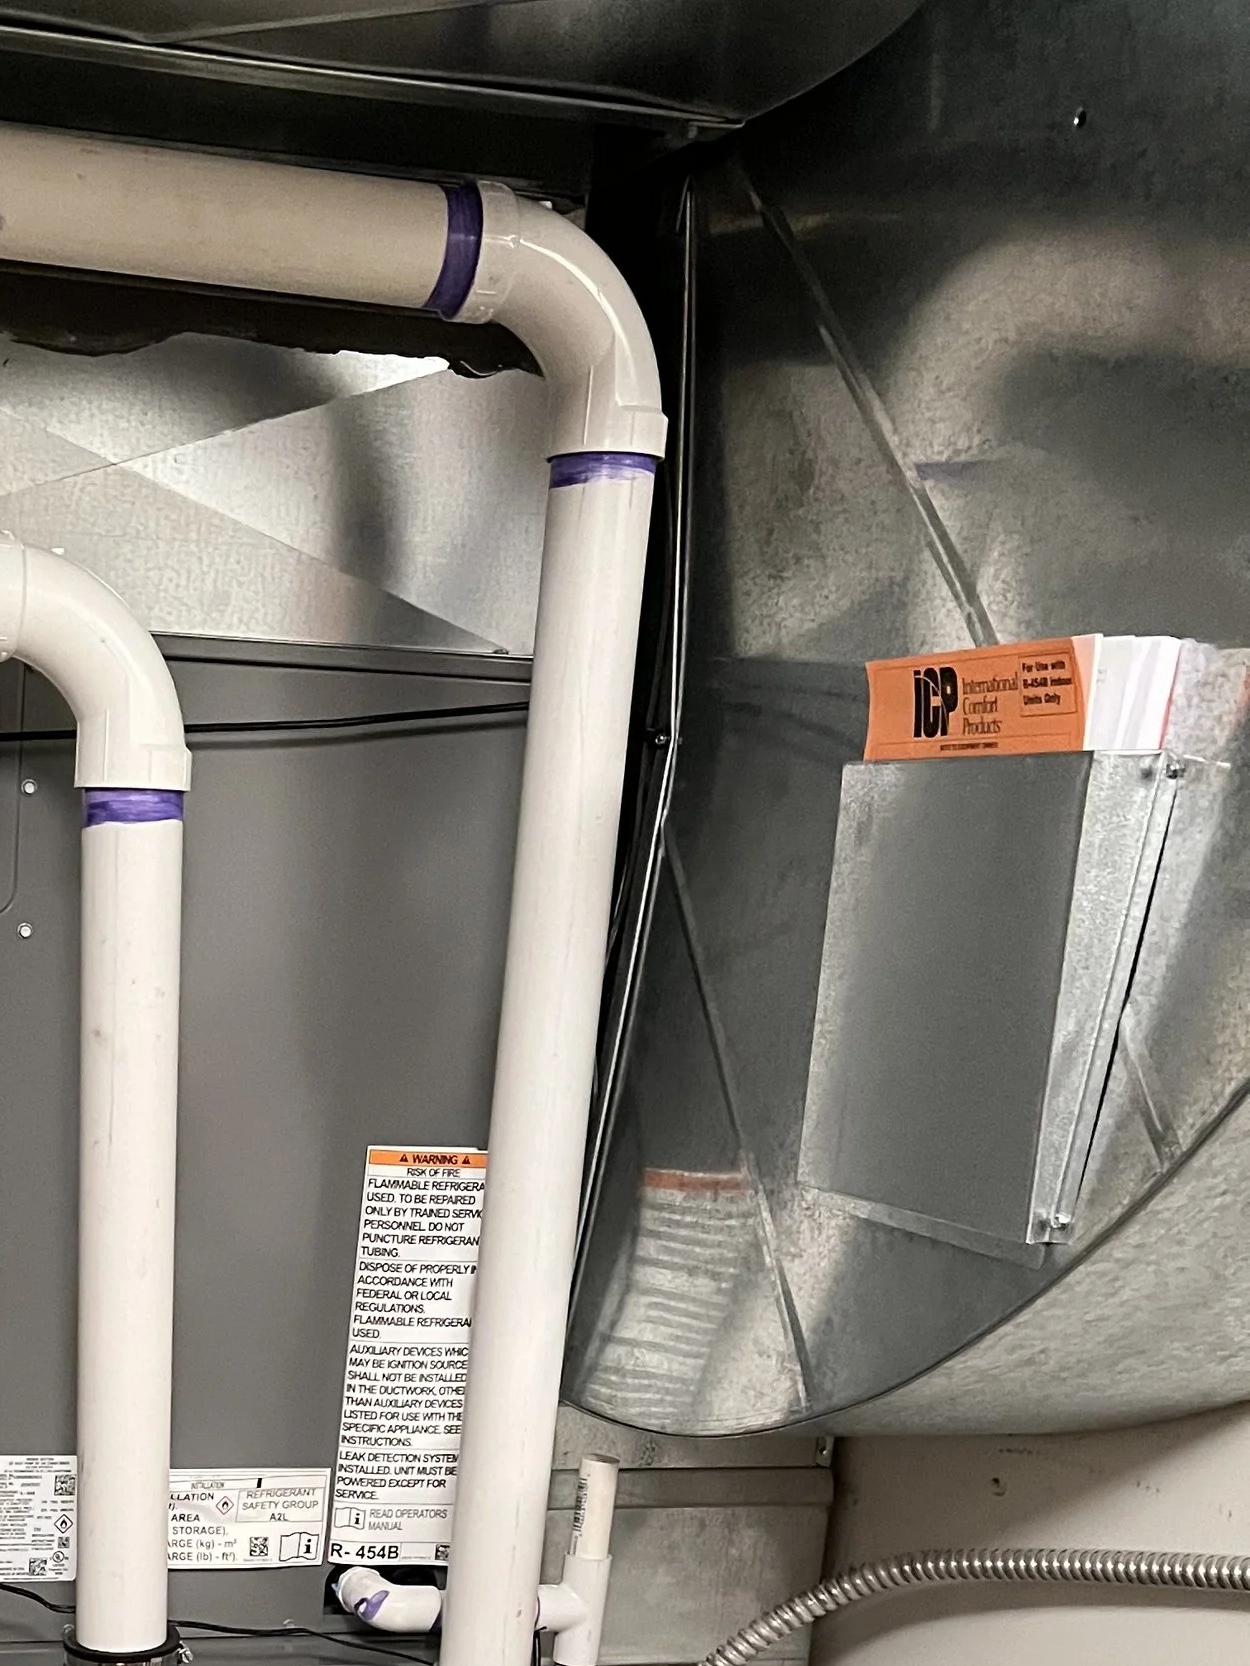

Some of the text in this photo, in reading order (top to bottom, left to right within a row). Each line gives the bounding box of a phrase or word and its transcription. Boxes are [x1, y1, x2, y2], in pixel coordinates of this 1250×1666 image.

[962, 672, 1018, 695] International
[963, 696, 998, 716] Comfort
[963, 716, 1002, 736] Products
[412, 1154, 458, 1165] WARNING
[407, 1168, 460, 1177] RISK OF FIRE
[368, 1178, 430, 1190] FLAMMABLE
[399, 1194, 412, 1203] TO
[414, 1194, 427, 1204] BE
[429, 1195, 475, 1205] REPAIRED
[365, 1206, 392, 1216] ONLY
[394, 1207, 408, 1217] BY
[410, 1208, 450, 1218] TRAINED
[429, 1222, 443, 1231] DO
[445, 1223, 465, 1232] NOT
[362, 1233, 417, 1244] PUNCTURE
[361, 1246, 400, 1257] TUBING.
[359, 1261, 403, 1273] DISPOSE
[405, 1264, 417, 1273] OF
[419, 1264, 471, 1274] PROPERLY
[357, 1275, 453, 1287] ACCORDANCE WITH
[356, 1288, 452, 1301] FEDERAL OR LOCAL
[355, 1301, 425, 1313] REGULATIONS.
[354, 1315, 416, 1326] FLAMMABLE
[350, 1344, 402, 1356] AUXILIARY
[403, 1347, 442, 1356] DEVICES
[349, 1357, 370, 1367] MAY
[372, 1359, 385, 1368] BE
[388, 1360, 428, 1369] IGNITION
[348, 1370, 380, 1381] SHALL
[382, 1373, 402, 1382] NOT
[404, 1373, 417, 1382] BE
[346, 1384, 356, 1393] IN
[359, 1384, 377, 1394] THE
[345, 1396, 463, 1408] THAN AUXILIARY DEVICES
[344, 1409, 463, 1421] LISTED FOR USE WITH THE
[342, 1422, 386, 1433] SPECIFIC
[443, 1425, 462, 1434] SEE
[341, 1435, 413, 1446] INSTRUCTIONS.
[339, 1451, 366, 1461] LEAK
[368, 1453, 421, 1462] DETECTION
[394, 1466, 415, 1475] UNIT
[417, 1467, 444, 1475] MUST
[445, 1467, 457, 1476] BE
[337, 1476, 446, 1488] POWERED EXCEPT FOR
[246, 1488, 316, 1499] REFRIGERANT
[242, 1501, 319, 1510] SAFETY GROUP
[171, 1514, 200, 1522] AREA
[269, 1513, 290, 1521] A2L
[370, 1509, 447, 1518] READ OPERATORS
[172, 1526, 228, 1536] STORAGE).
[369, 1521, 403, 1530] MANUAL
[196, 1538, 215, 1549] (kg)
[196, 1551, 212, 1562] (lb)
[356, 1545, 398, 1560] 454B
